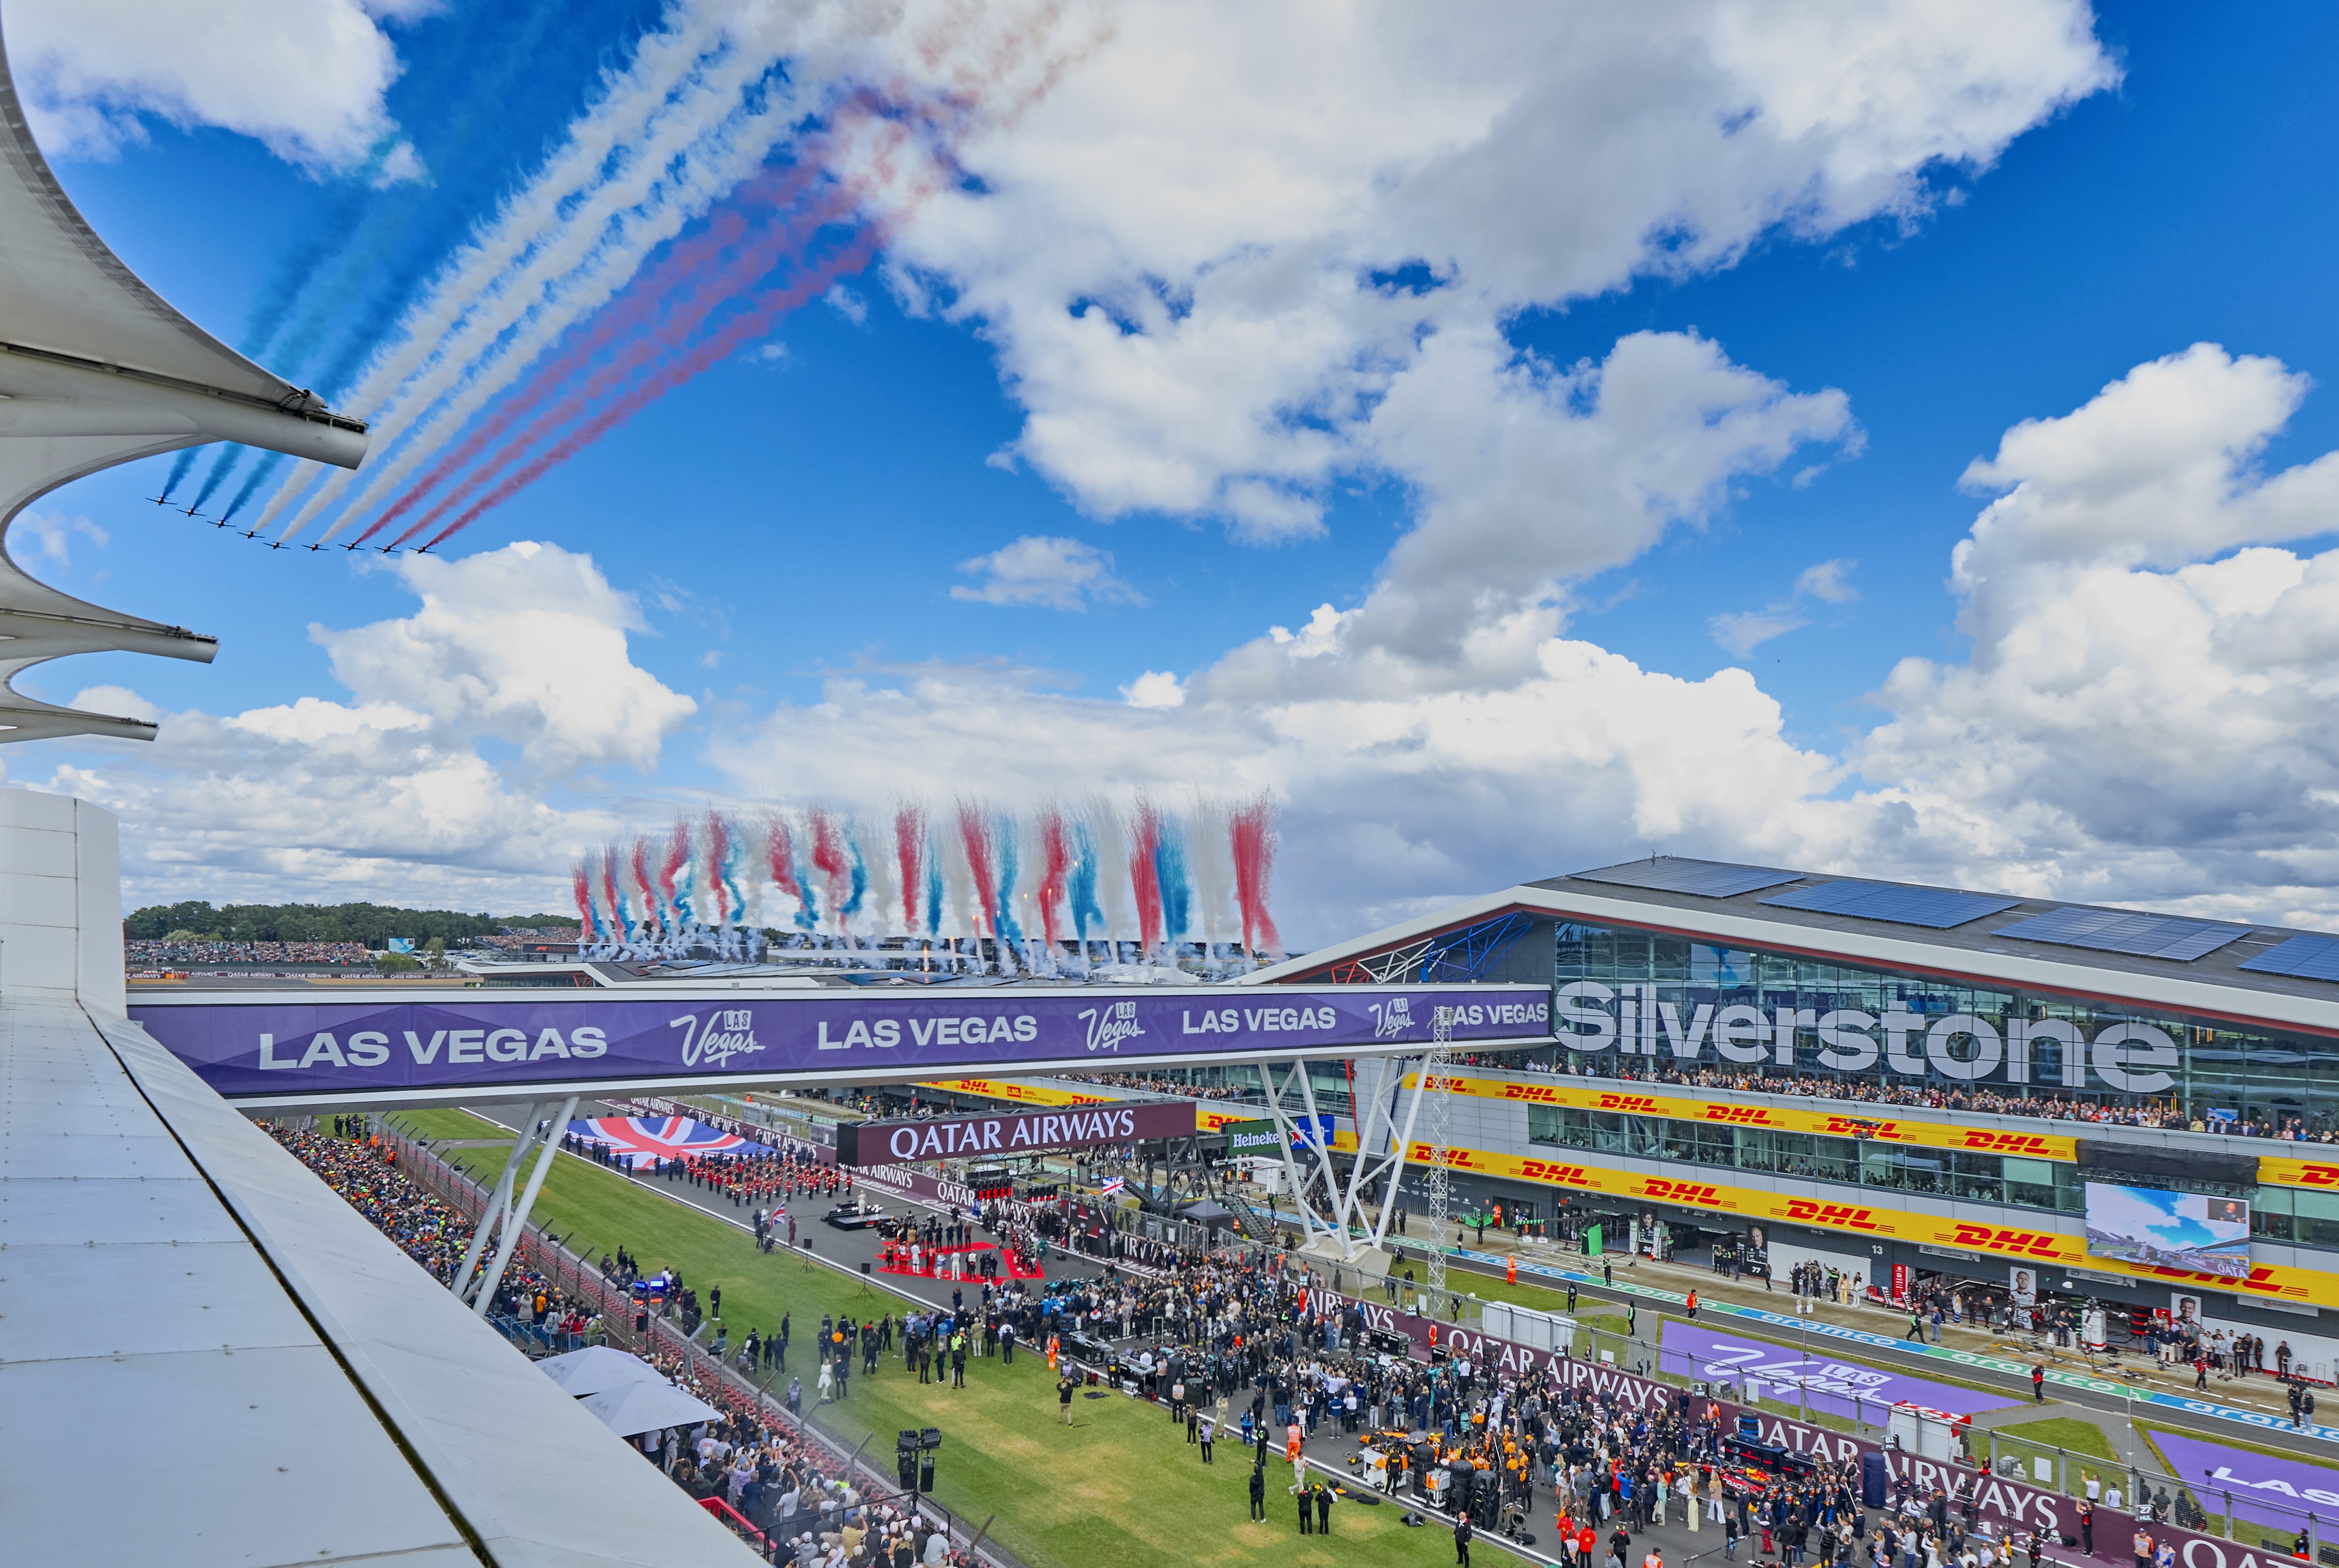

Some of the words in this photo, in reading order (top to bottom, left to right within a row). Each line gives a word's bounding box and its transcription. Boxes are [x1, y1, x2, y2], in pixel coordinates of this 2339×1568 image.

[1116, 1002, 1135, 1018] LAS
[1394, 998, 1408, 1012] LAS
[1486, 1003, 1549, 1024] VEGAS
[725, 1012, 750, 1030] LAS
[818, 1019, 901, 1050] LAS
[908, 1015, 1038, 1046] VEGAS
[1078, 1005, 1145, 1052] Vegas
[1183, 1009, 1239, 1034] LAS
[1244, 1007, 1336, 1031] VEGAS
[1369, 1004, 1415, 1039] Vegas
[259, 1031, 390, 1070] LAS
[403, 1027, 608, 1064] VEGAS
[670, 1010, 766, 1068] Vegas
[1555, 981, 2179, 1093] Silverstone
[961, 1080, 990, 1093] DHL
[1505, 1085, 1558, 1102] DHL
[649, 1097, 674, 1115] AIRWAYS
[1600, 1094, 1659, 1113] DHL
[1706, 1105, 1772, 1126] DHL
[890, 1120, 1001, 1160] QATAR
[1011, 1110, 1135, 1147] AIRWAYS
[1826, 1117, 1902, 1140] DHL
[1964, 1131, 2050, 1155] DHL
[1415, 1145, 1473, 1167] DHL
[870, 1165, 913, 1189] AIRWAYS
[1522, 1160, 1589, 1185] DHL
[937, 1182, 975, 1207] QATAR
[1644, 1179, 1721, 1206] DHL
[1787, 1199, 1877, 1230] DHL
[1872, 1245, 1883, 1255] 13
[1953, 1224, 2062, 1259] DHL
[1752, 1265, 1761, 1273] 77
[1761, 1314, 1897, 1346] aramco
[1547, 1357, 1668, 1409] AIRWAYS
[1824, 1365, 1886, 1385] LAS
[1883, 1451, 2058, 1530] AIRWAYS
[2212, 1466, 2339, 1507] LAS
